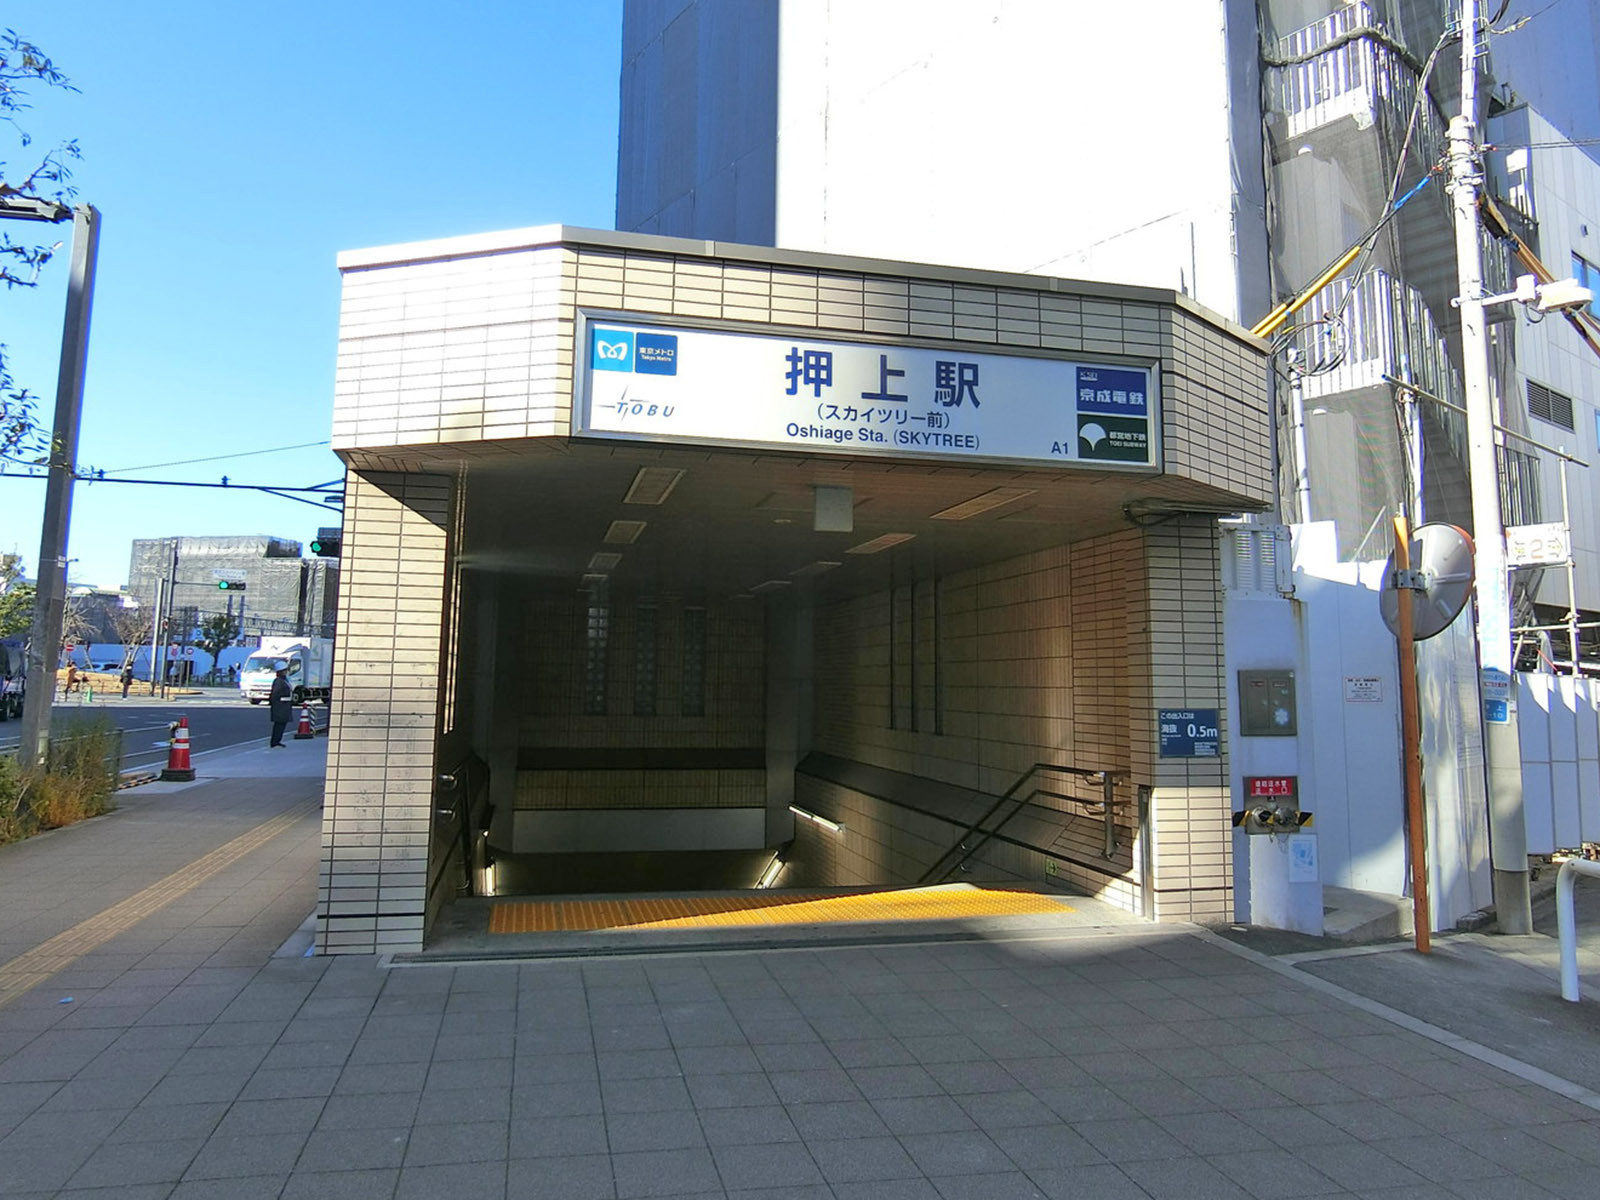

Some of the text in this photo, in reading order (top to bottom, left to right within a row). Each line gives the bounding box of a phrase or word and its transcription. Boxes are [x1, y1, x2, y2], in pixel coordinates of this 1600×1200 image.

[639, 347, 675, 357] 東京メトロ
[641, 354, 656, 362] Tokyo
[785, 347, 981, 409] 押上駅
[1079, 388, 1144, 405] 京成電鉄
[616, 402, 675, 417] TOBU
[786, 423, 980, 450] Oshiage Sta. (SKYTREE)
[1051, 441, 1069, 454] A1
[1187, 723, 1218, 738] 0.5m
